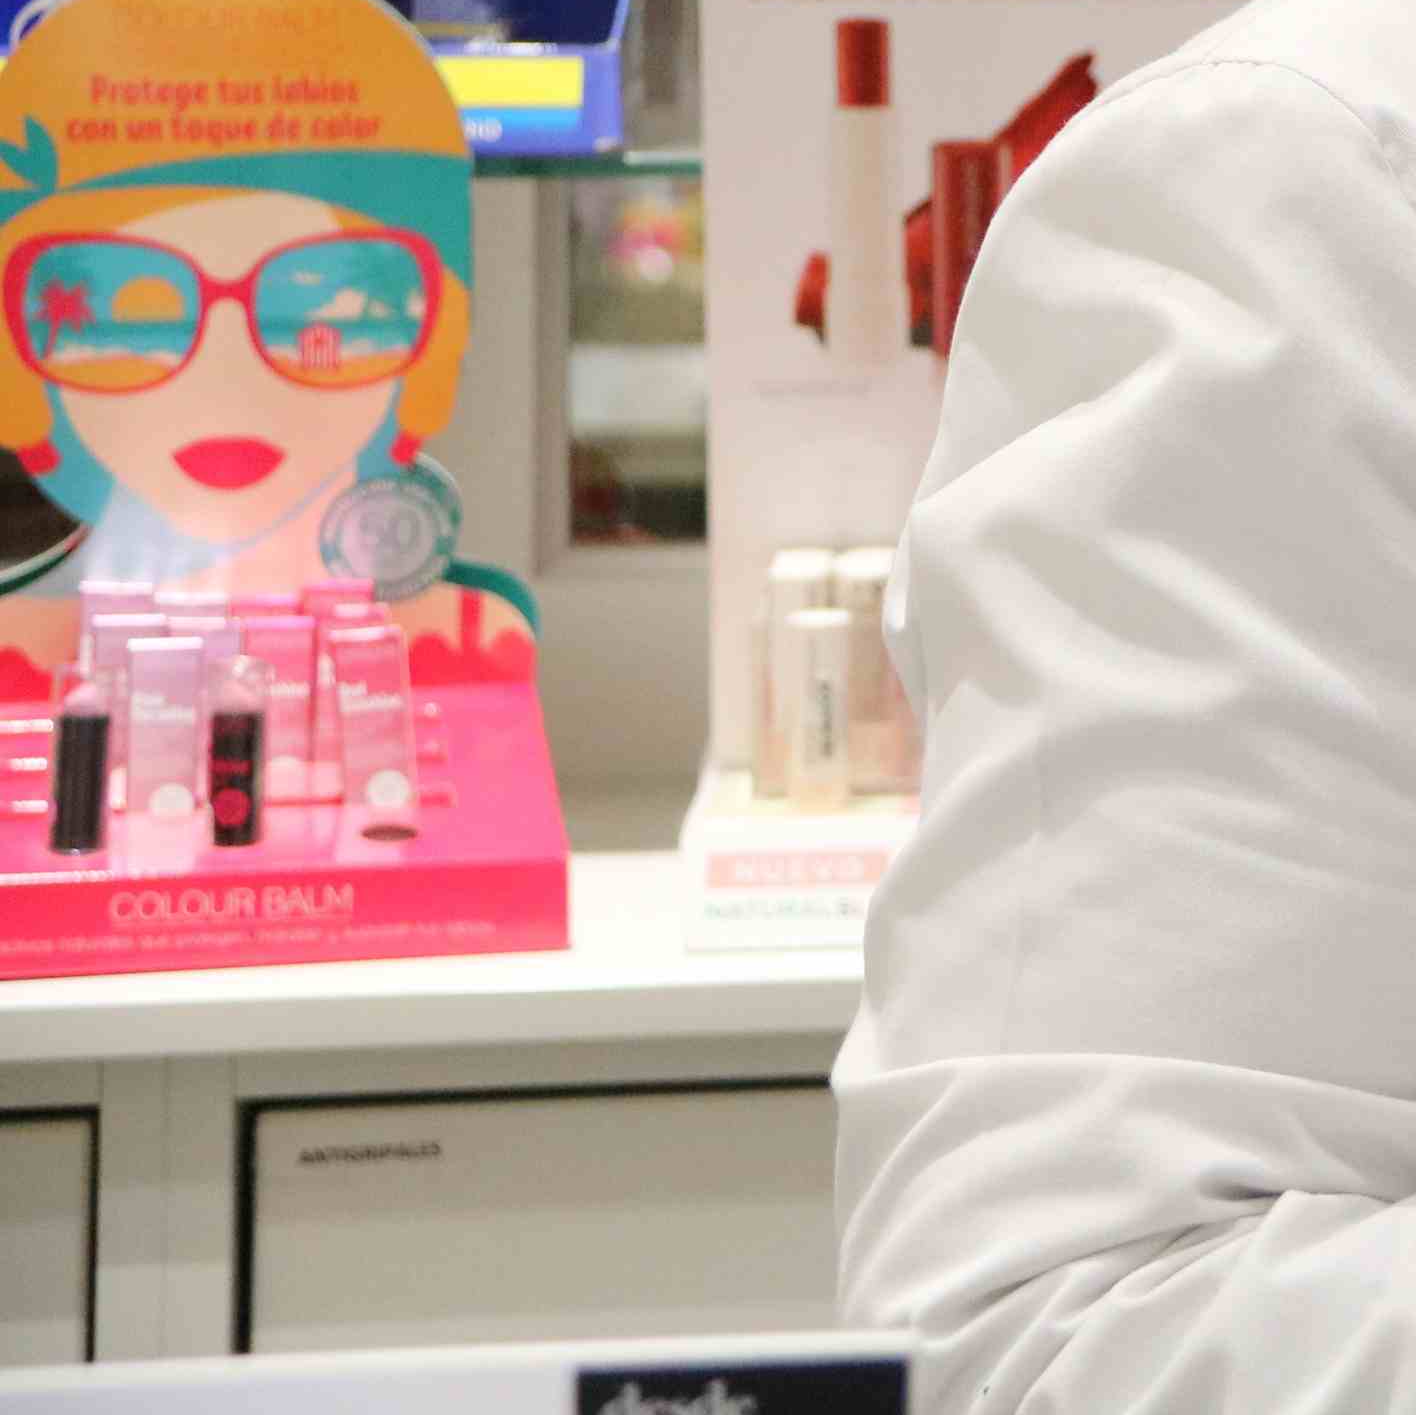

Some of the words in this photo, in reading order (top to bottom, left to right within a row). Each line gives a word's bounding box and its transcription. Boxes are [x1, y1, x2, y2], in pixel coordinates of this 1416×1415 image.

[91, 74, 207, 111] Protege
[218, 79, 266, 105] tus
[275, 74, 359, 105] labios
[67, 117, 118, 141] con
[126, 118, 163, 141] un
[170, 113, 259, 146] toque
[268, 111, 301, 141] de
[312, 110, 382, 141] color
[107, 890, 255, 922] COLOUR
[263, 885, 354, 919] BALM
